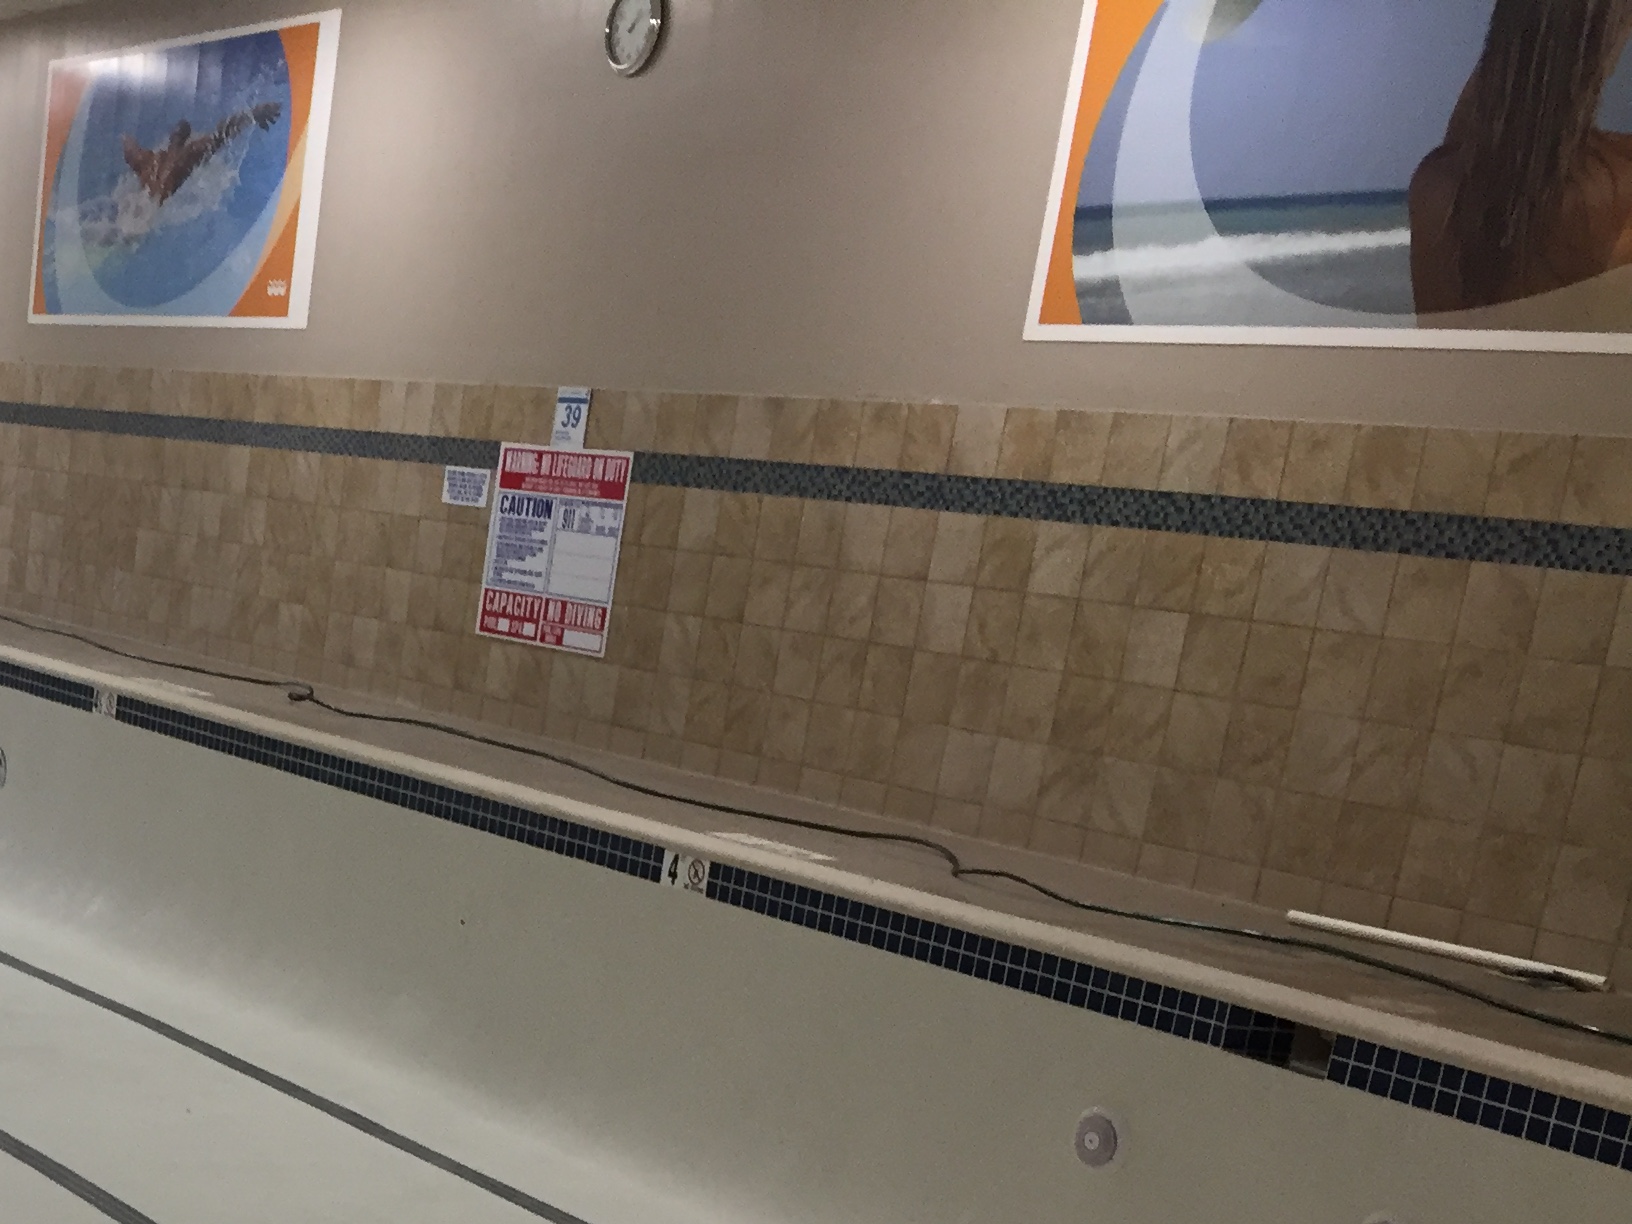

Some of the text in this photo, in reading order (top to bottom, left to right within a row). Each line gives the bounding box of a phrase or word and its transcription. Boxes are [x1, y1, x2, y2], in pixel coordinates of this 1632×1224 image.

[561, 404, 582, 428] 39
[499, 494, 553, 520] CAUTION
[561, 508, 576, 529] 911
[485, 590, 542, 620] CAPACITY
[546, 599, 603, 630] NO DIVING
[668, 853, 680, 886] 4
